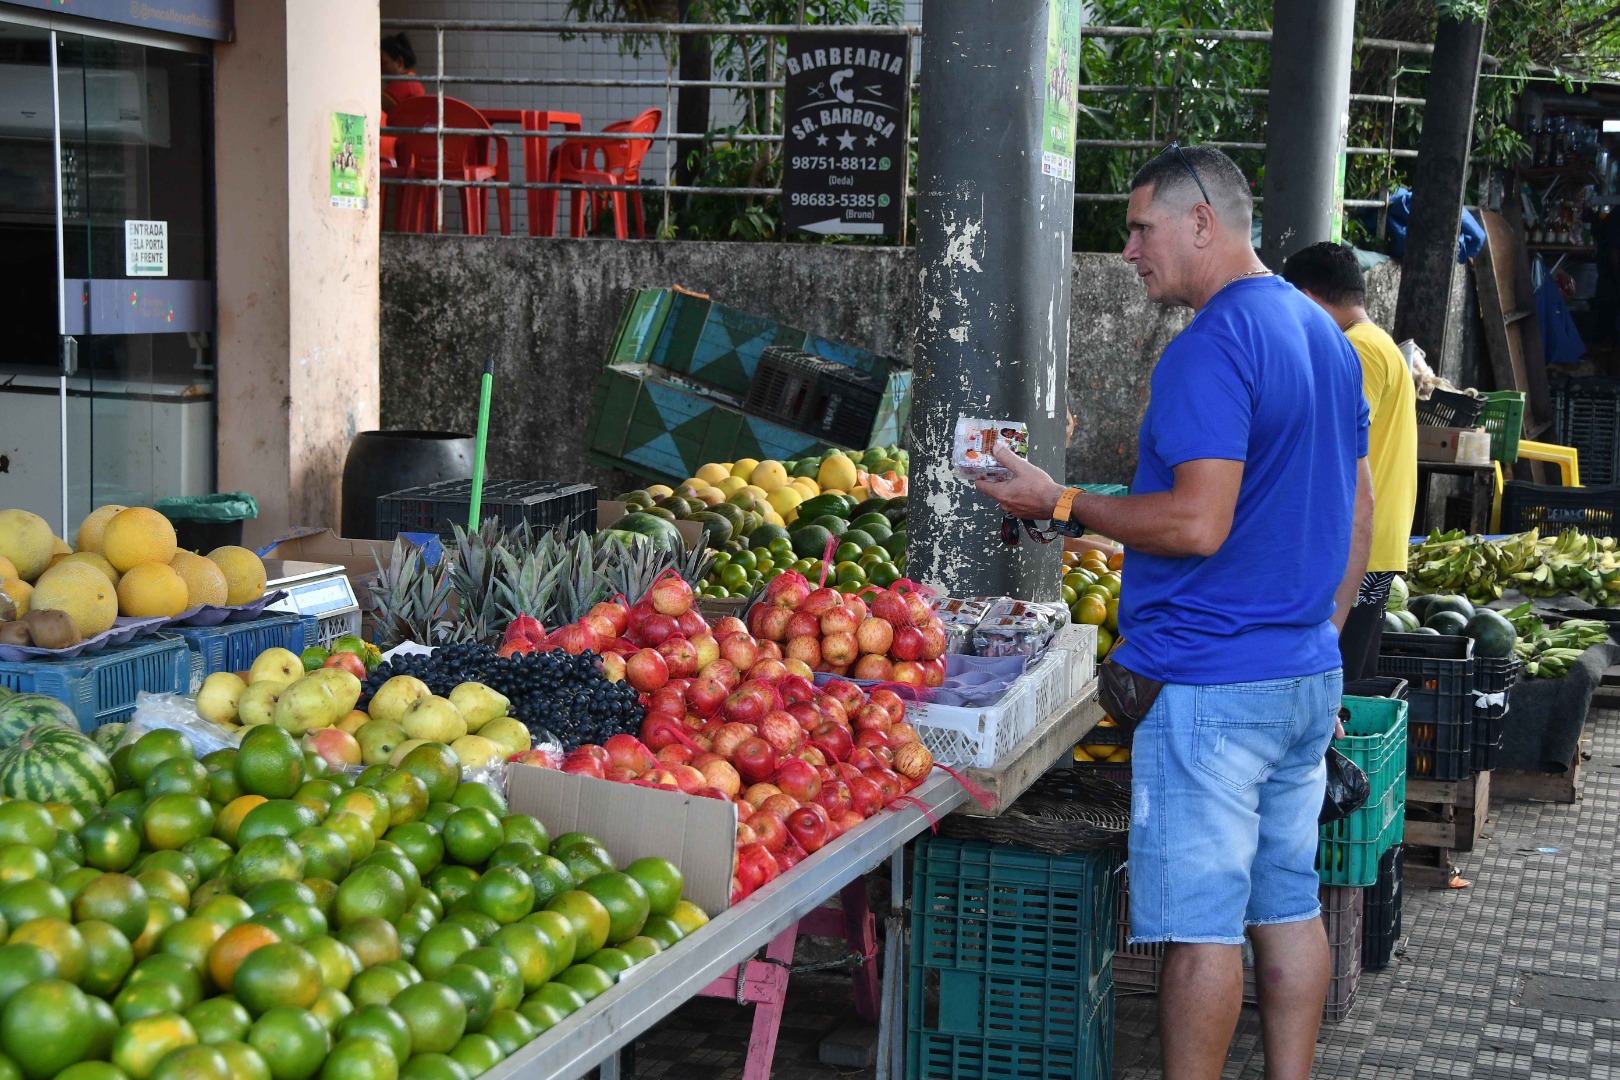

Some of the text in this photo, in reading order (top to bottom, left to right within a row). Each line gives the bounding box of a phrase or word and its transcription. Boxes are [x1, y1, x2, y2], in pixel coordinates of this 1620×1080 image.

[787, 47, 903, 75] BARBEARIA
[791, 108, 896, 140] SR. BARBOSA
[791, 156, 876, 170] 98751-8812
[828, 175, 854, 186] (Deda)
[791, 193, 876, 207] 98683-5385
[845, 209, 875, 220] (Bruno)
[130, 223, 164, 236] ENTRADA
[145, 239, 164, 250] PORTA
[140, 252, 163, 263] FRENTE
